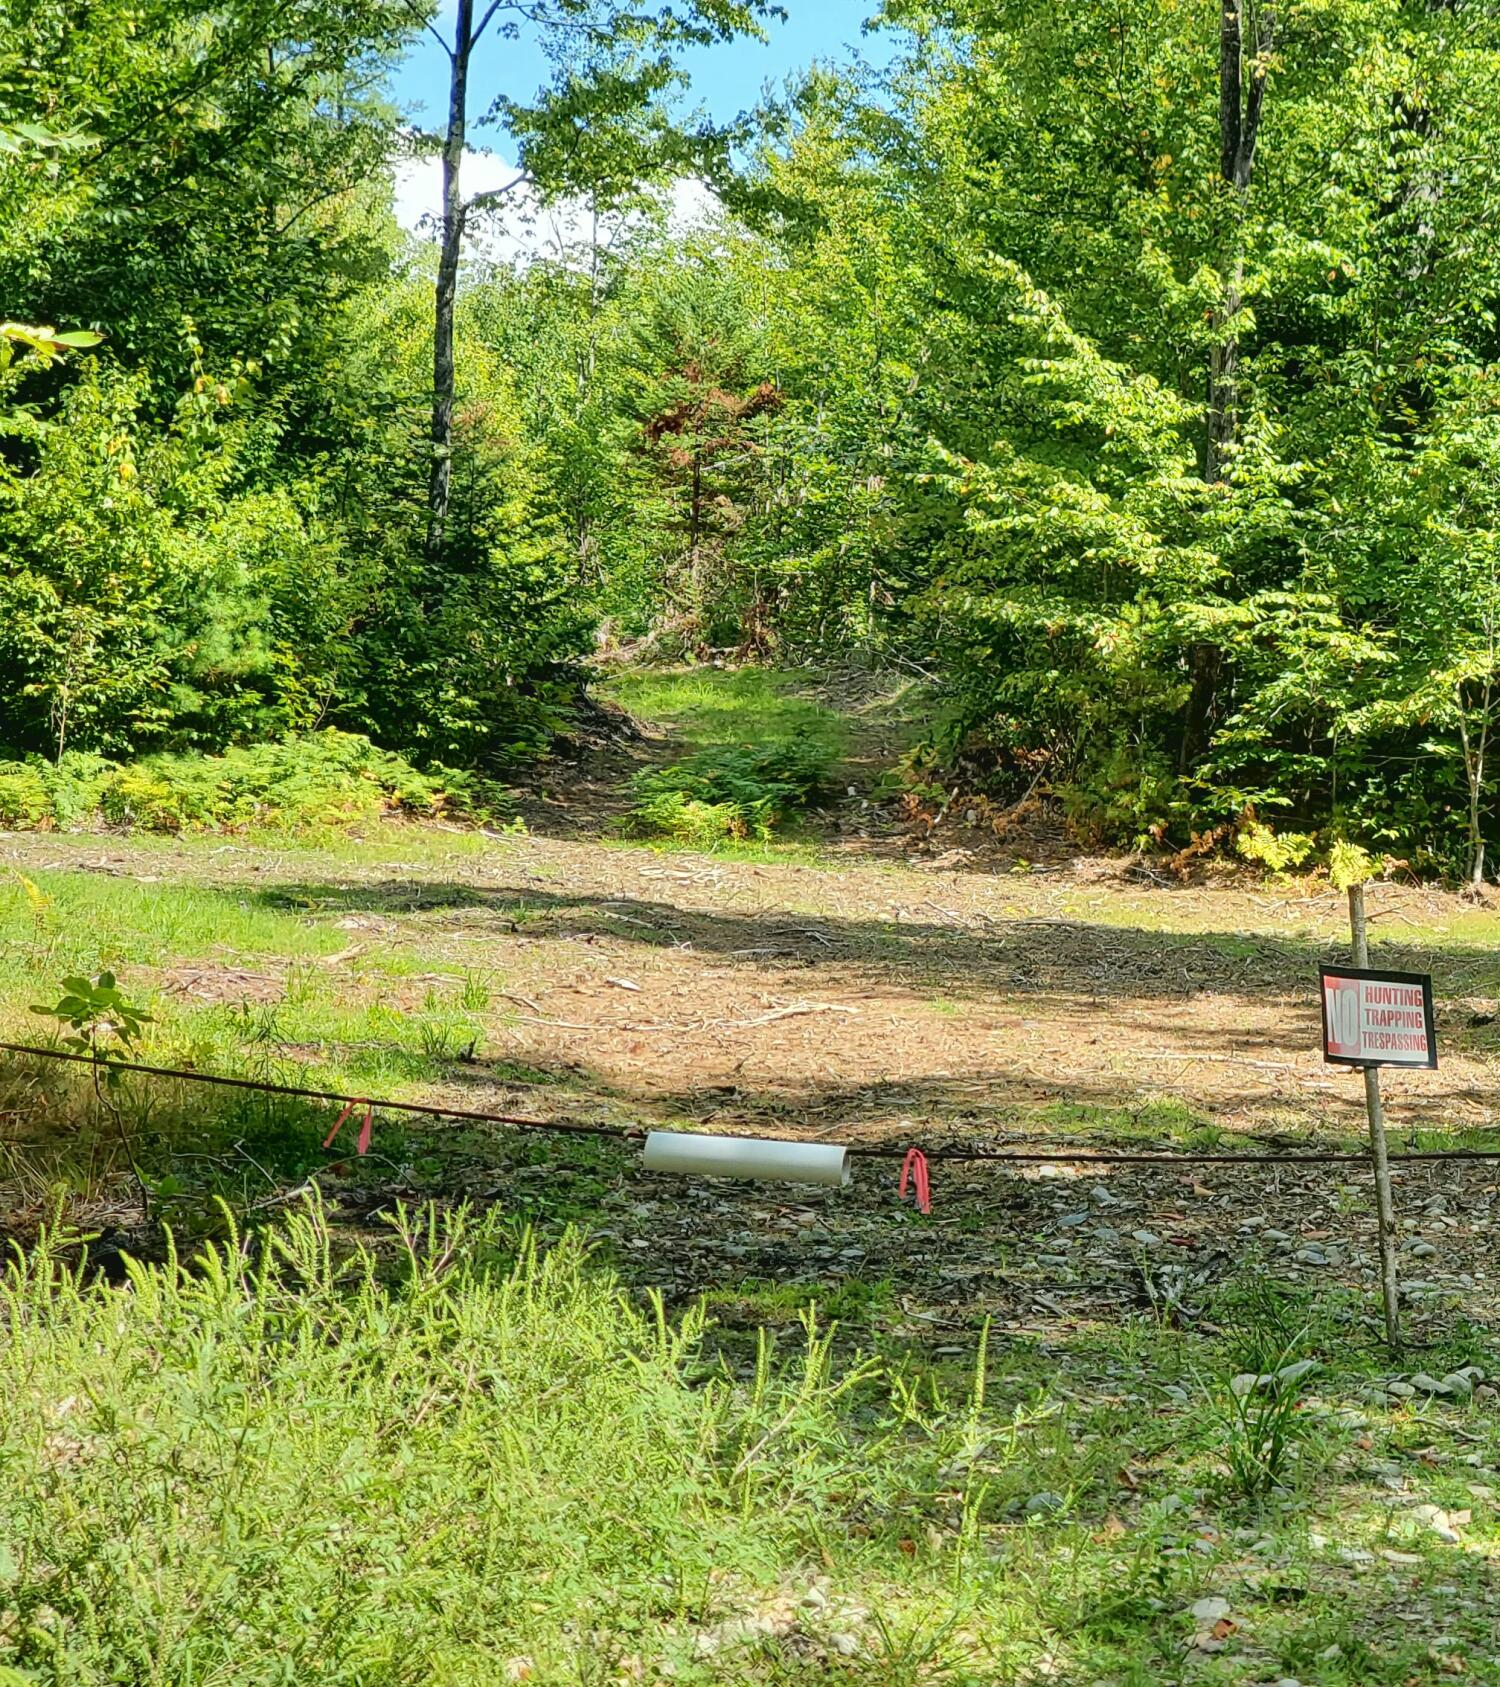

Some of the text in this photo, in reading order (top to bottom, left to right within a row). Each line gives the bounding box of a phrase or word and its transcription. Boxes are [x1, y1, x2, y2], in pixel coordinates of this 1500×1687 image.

[1365, 986, 1423, 1007] HUNTING
[1326, 988, 1358, 1046] NO
[1364, 1008, 1423, 1029] TRAPPING
[1362, 1031, 1427, 1052] TRESPASSING
